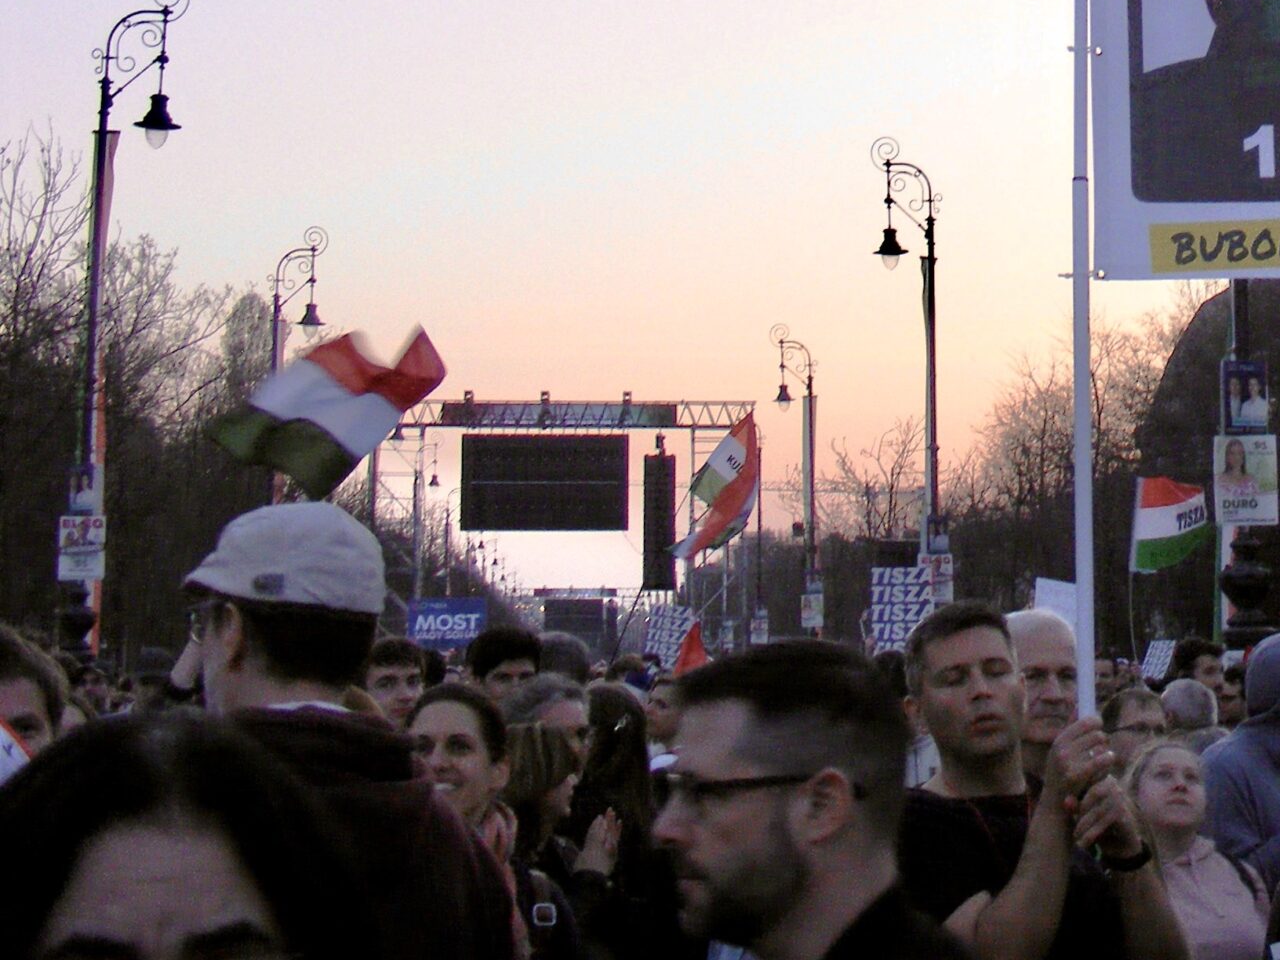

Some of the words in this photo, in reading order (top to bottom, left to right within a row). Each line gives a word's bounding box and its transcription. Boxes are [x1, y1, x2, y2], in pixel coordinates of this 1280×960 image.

[1177, 505, 1204, 531] TISZA
[871, 567, 933, 585] TISZA
[871, 585, 933, 603] TISZA
[415, 613, 480, 630] MOST
[871, 603, 935, 622] TISZA
[871, 622, 916, 640] TIS
